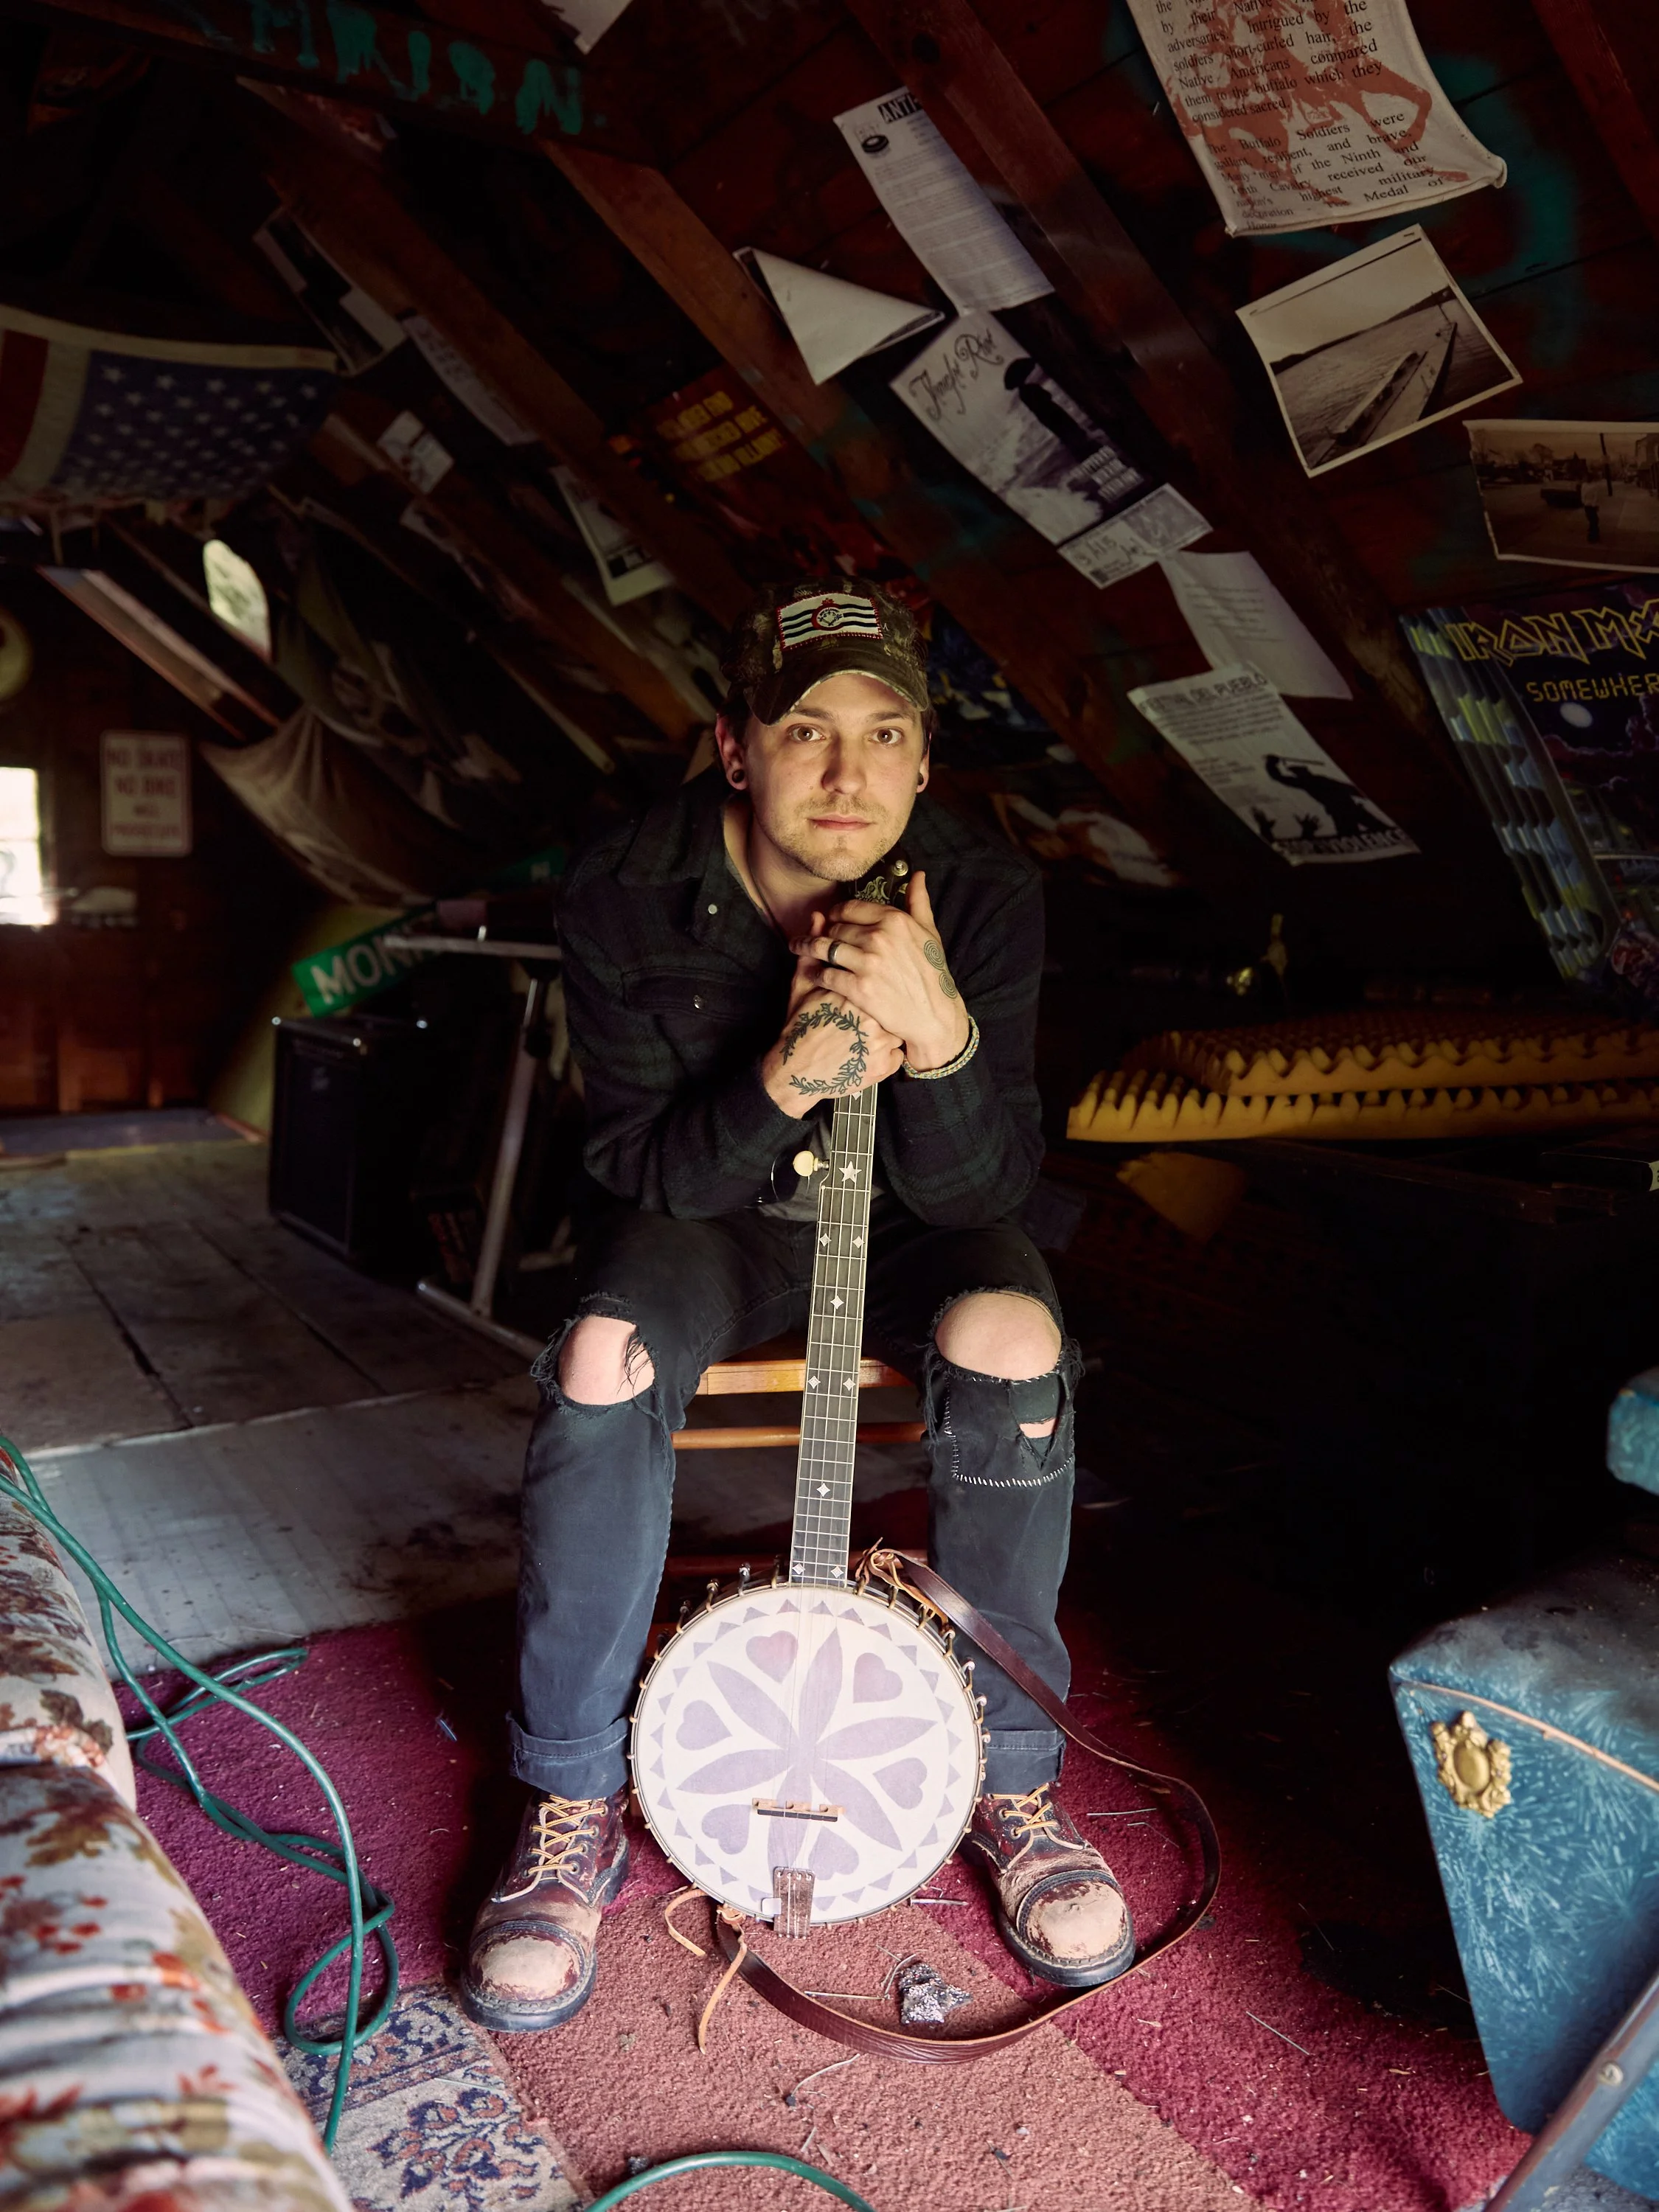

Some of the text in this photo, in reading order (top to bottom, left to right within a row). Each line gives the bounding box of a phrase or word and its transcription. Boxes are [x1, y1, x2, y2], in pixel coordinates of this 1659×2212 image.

[1155, 0, 1172, 14] the
[1161, 0, 1273, 35] by their Native
[1168, 0, 1368, 52] adversaries. Intrigued by the
[1174, 21, 1372, 72] soldiers short-curled hair, the
[1179, 38, 1377, 89] Native Americans compared
[1186, 61, 1382, 107] them to the buffalo which they
[1192, 97, 1290, 122] considered sacred.
[1239, 137, 1281, 150] Buffalo
[1296, 123, 1350, 141] Soldiers
[1369, 113, 1405, 128] were
[1259, 170, 1281, 179] men
[1291, 163, 1302, 175] of
[1312, 159, 1331, 170] the
[1341, 149, 1381, 164] Ninth
[1394, 141, 1419, 154] and
[1262, 147, 1312, 164] resilient,
[1327, 138, 1352, 151] and
[1270, 179, 1311, 192] Cavalry
[1327, 163, 1384, 181] received
[1403, 155, 1427, 167] our
[1299, 186, 1343, 202] highest
[1378, 166, 1434, 185] military
[1363, 184, 1409, 203] Medal
[1427, 175, 1444, 188] of
[1526, 672, 1659, 703] SOMEWHER
